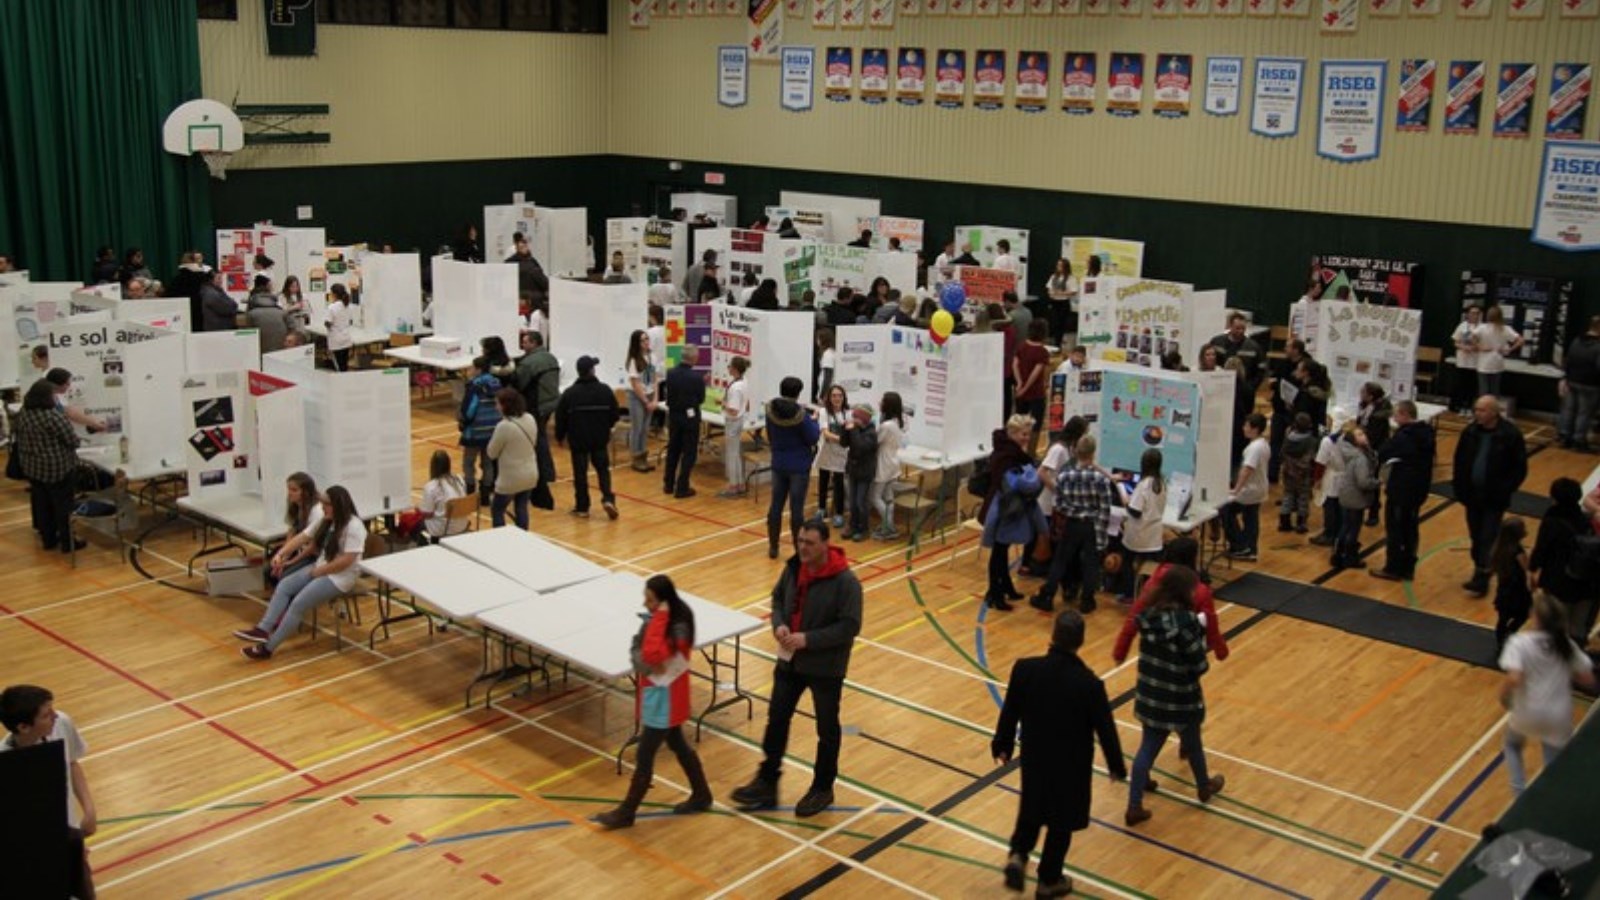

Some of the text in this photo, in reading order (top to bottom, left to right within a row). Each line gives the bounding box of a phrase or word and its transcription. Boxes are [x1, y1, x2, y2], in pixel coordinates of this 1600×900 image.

[1260, 69, 1297, 80] RSEQ
[1328, 77, 1377, 91] RSEQ
[49, 332, 72, 348] Le
[80, 327, 107, 346] sol
